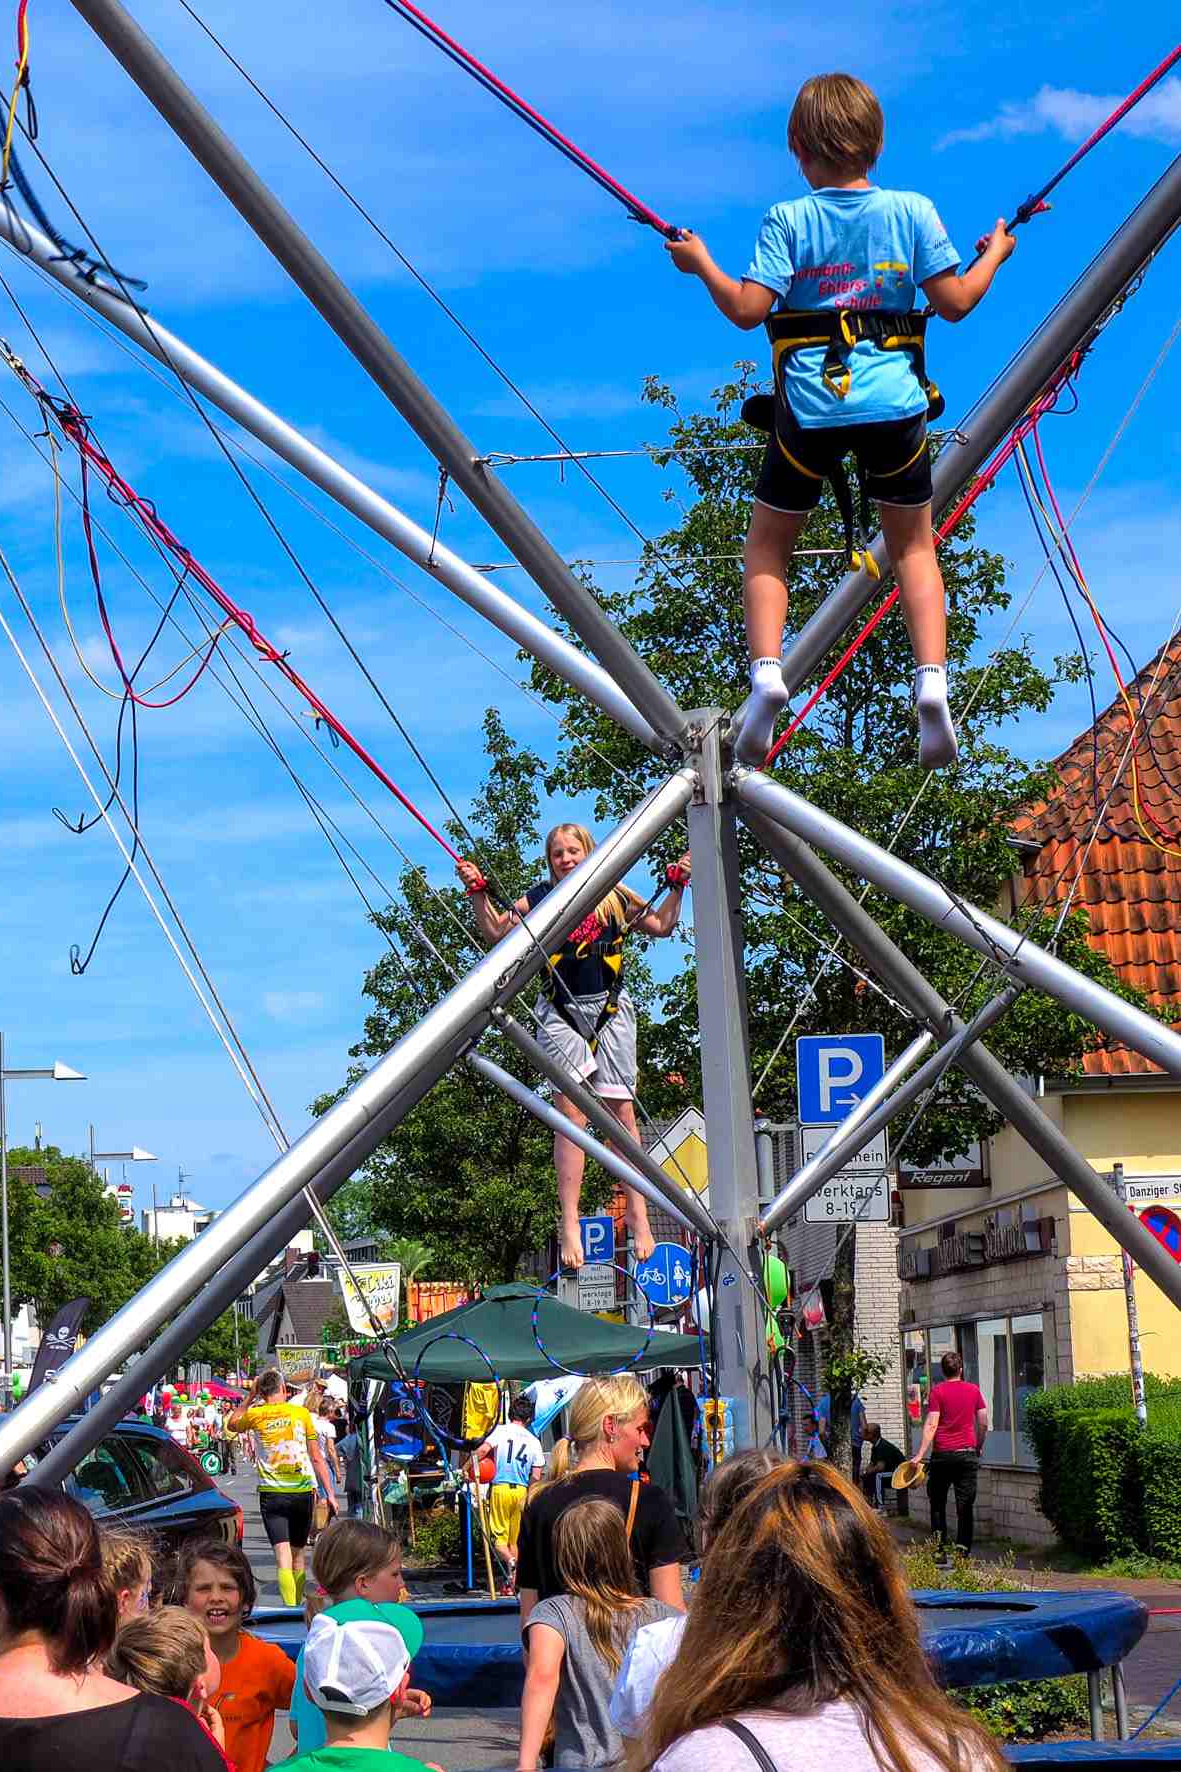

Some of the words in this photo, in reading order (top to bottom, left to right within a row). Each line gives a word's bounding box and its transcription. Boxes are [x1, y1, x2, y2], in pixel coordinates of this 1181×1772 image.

[818, 1048, 864, 1112] P
[910, 1171, 971, 1186] Regent
[1129, 1185, 1169, 1198] Danziger
[585, 1223, 605, 1256] P
[505, 1438, 529, 1466] 14
